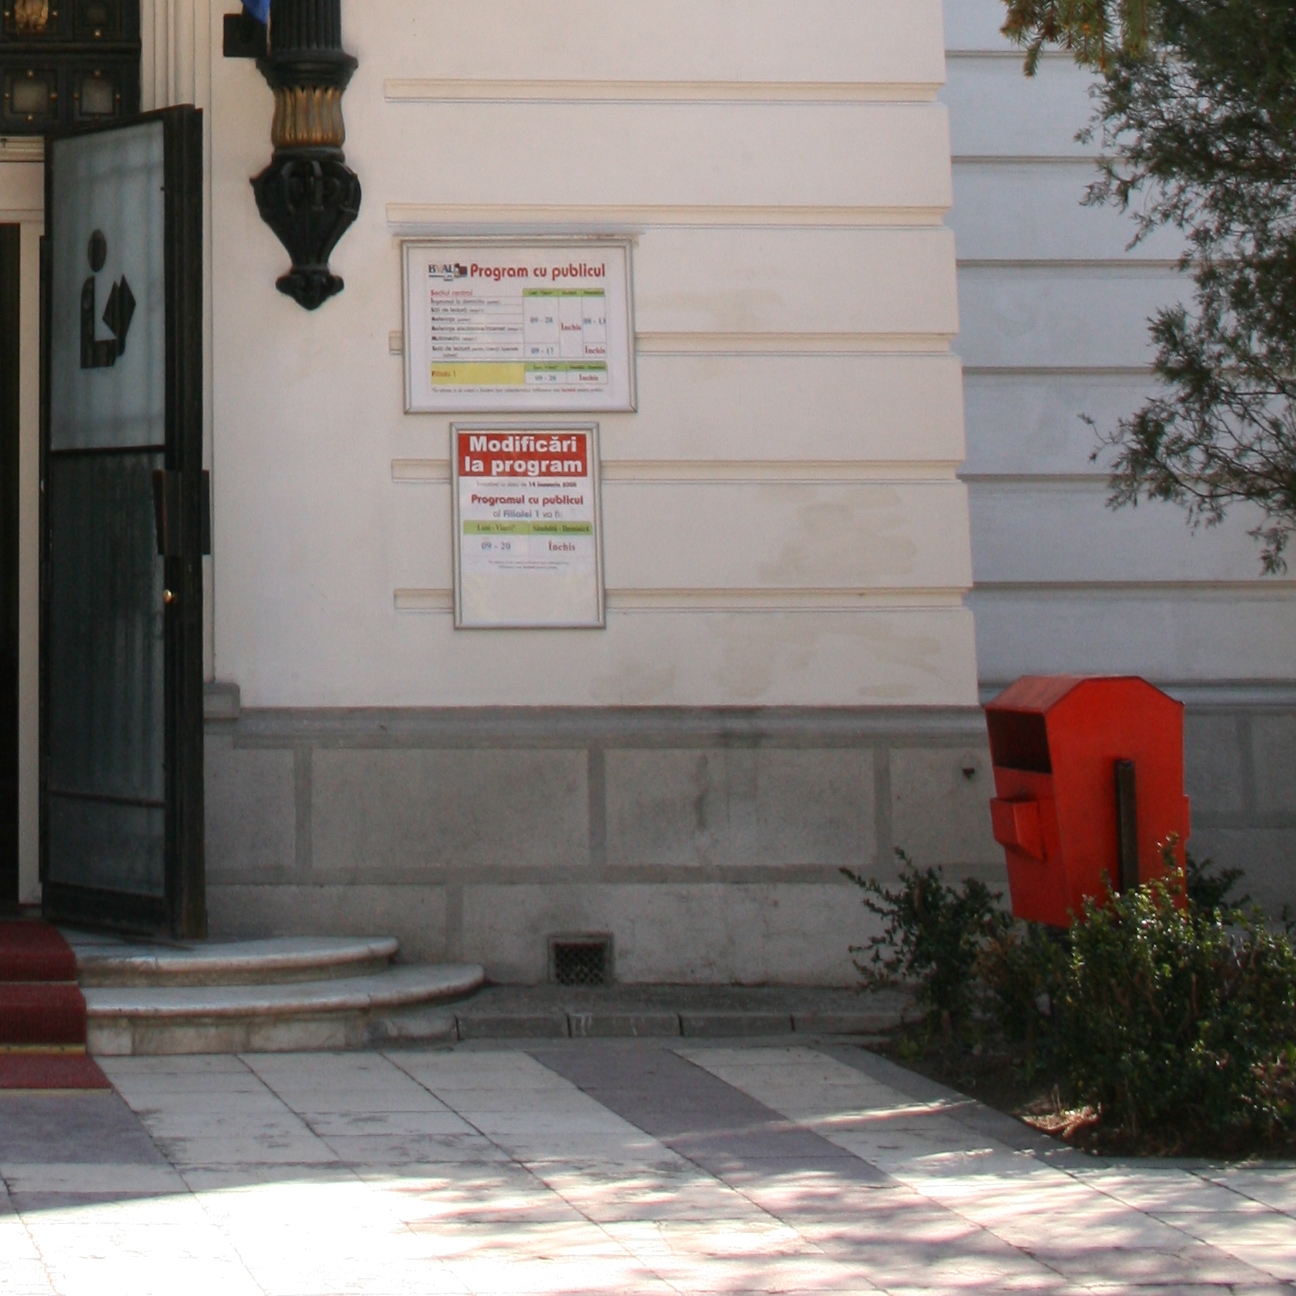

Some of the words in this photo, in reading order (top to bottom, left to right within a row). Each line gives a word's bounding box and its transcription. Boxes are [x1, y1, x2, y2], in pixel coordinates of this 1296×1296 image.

[470, 263, 529, 281] Program
[533, 267, 547, 277] cu
[551, 263, 605, 281] publicul
[469, 435, 577, 453] Modificări
[465, 455, 484, 473] la
[491, 459, 583, 477] program
[471, 494, 525, 507] Programul
[528, 497, 540, 505] cu
[542, 495, 584, 507] publicul
